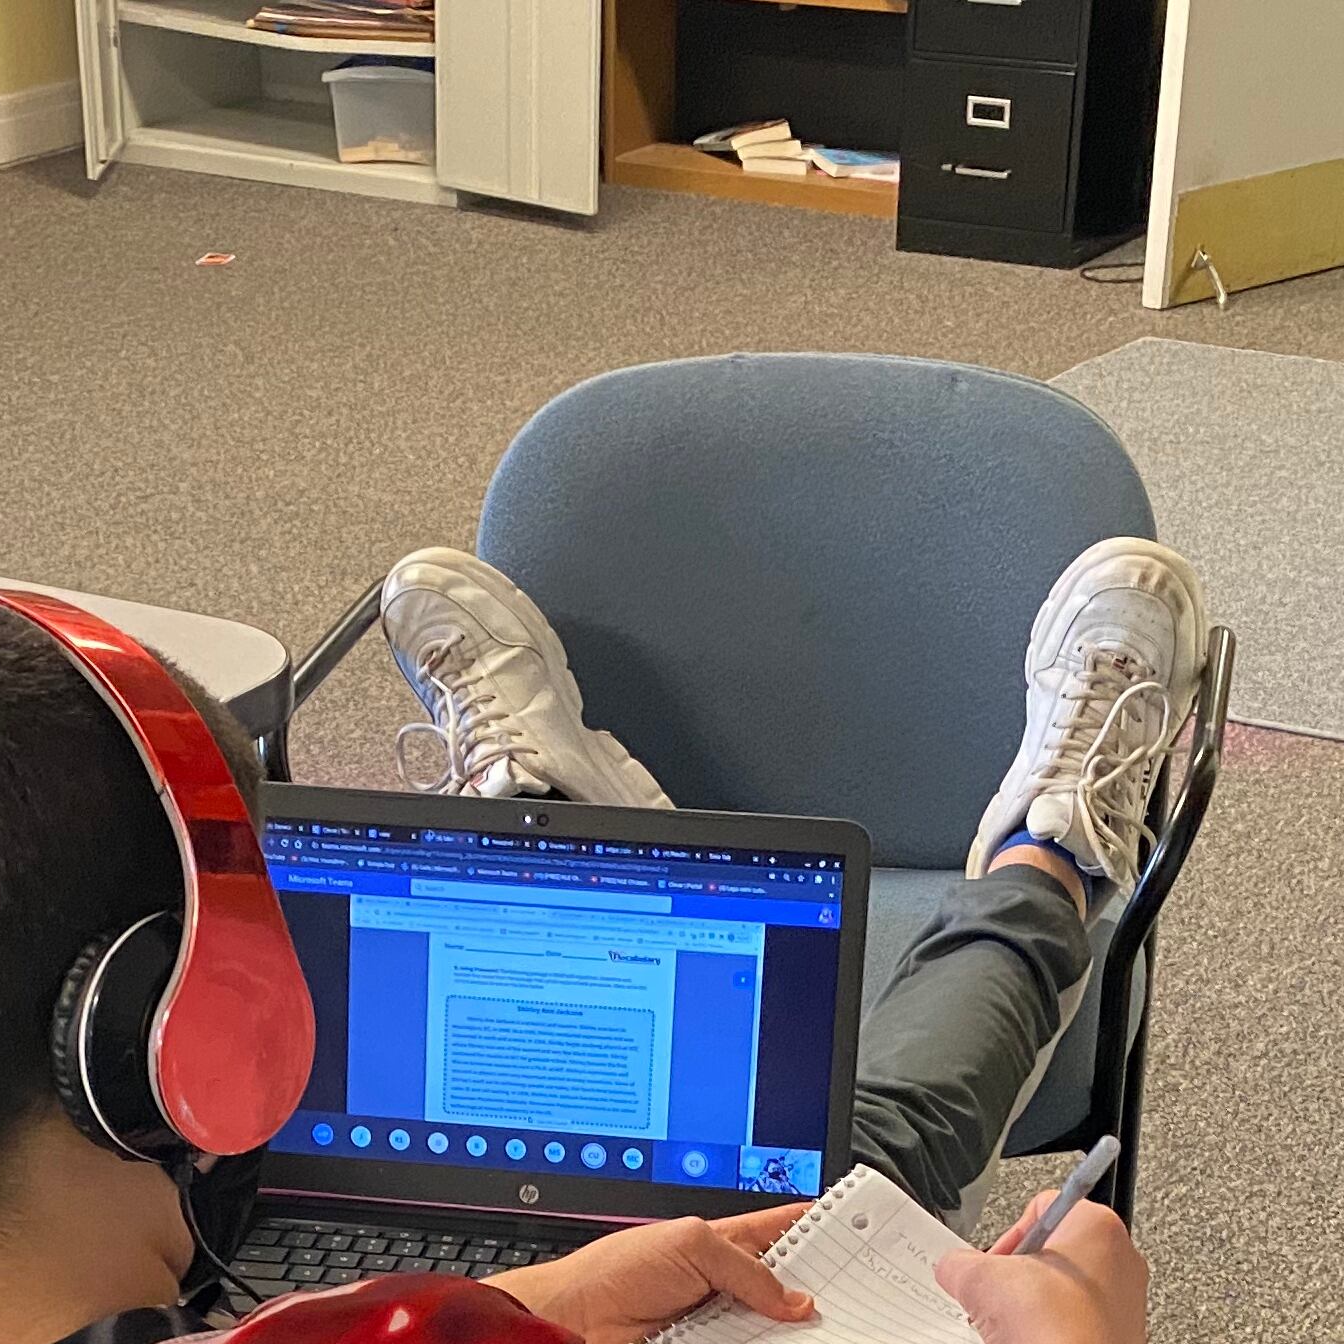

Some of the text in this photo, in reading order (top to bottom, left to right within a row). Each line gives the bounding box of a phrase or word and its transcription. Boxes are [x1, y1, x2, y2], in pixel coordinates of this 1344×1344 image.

[287, 873, 353, 888] Microsoft Teams
[520, 1184, 539, 1204] hp
